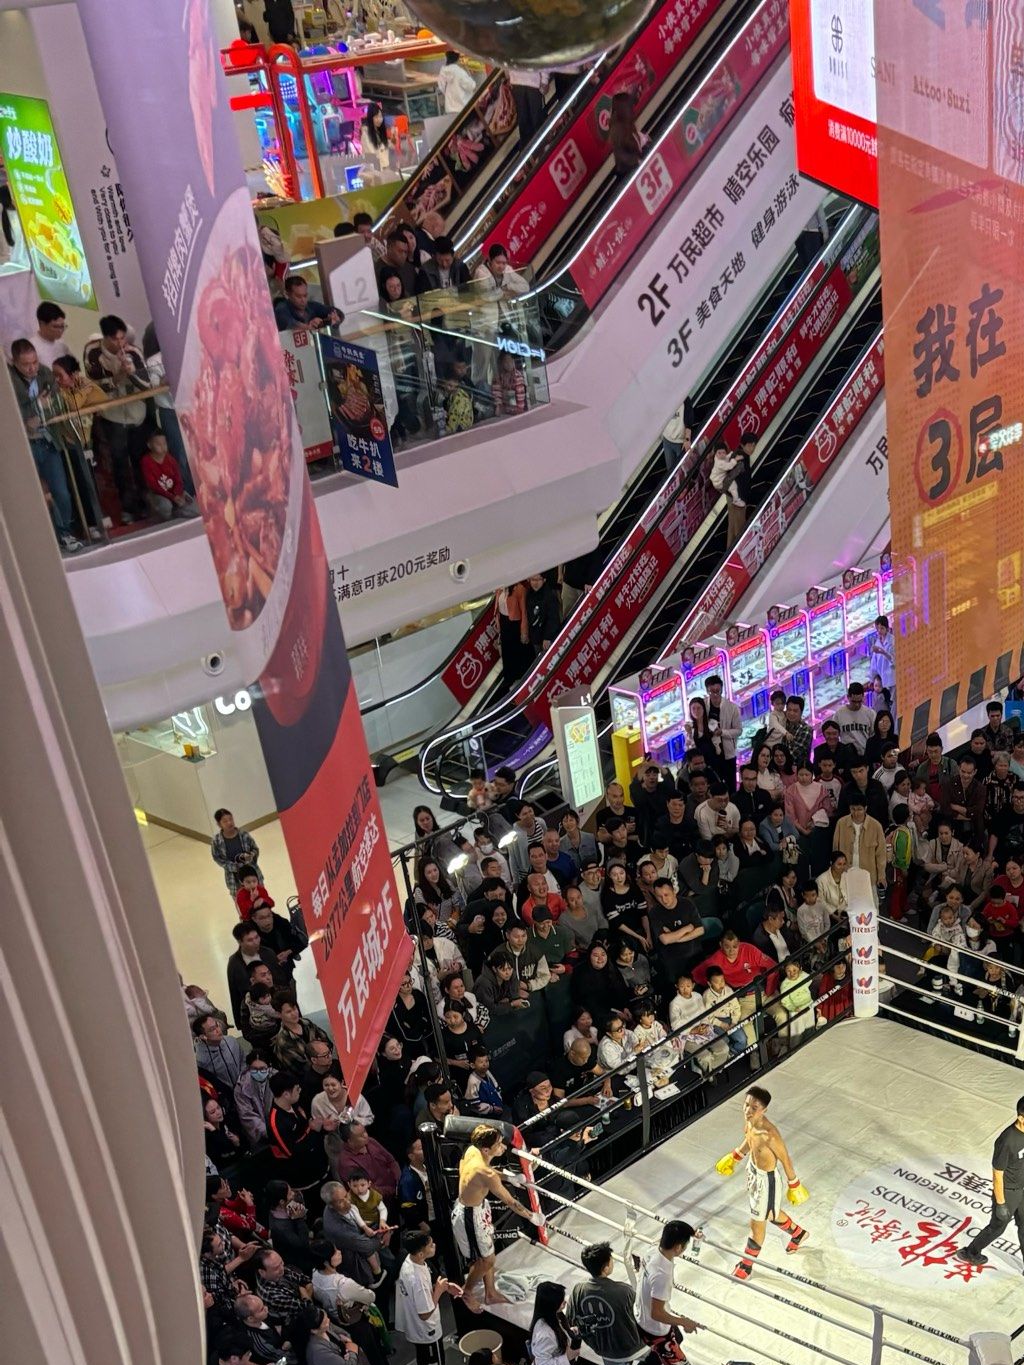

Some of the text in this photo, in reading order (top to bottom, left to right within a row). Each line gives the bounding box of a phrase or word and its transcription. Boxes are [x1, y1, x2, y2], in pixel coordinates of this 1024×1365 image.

[6, 126, 54, 168] 炒酸奶
[553, 144, 578, 187] 3F
[641, 157, 665, 200] 3F
[637, 272, 671, 328] 2F
[667, 203, 726, 284] 万民超市
[722, 124, 781, 205] 晴空乐园
[667, 174, 800, 369] 3F 美食天地 健身游泳
[912, 282, 1007, 398] 我在
[333, 545, 450, 603] 满意可获200元奖励
[337, 879, 393, 1054] 万民城3F
[892, 1167, 946, 1195] REGION
[870, 1184, 963, 1229] LEGENDS
[927, 1325, 958, 1343] BOXING
